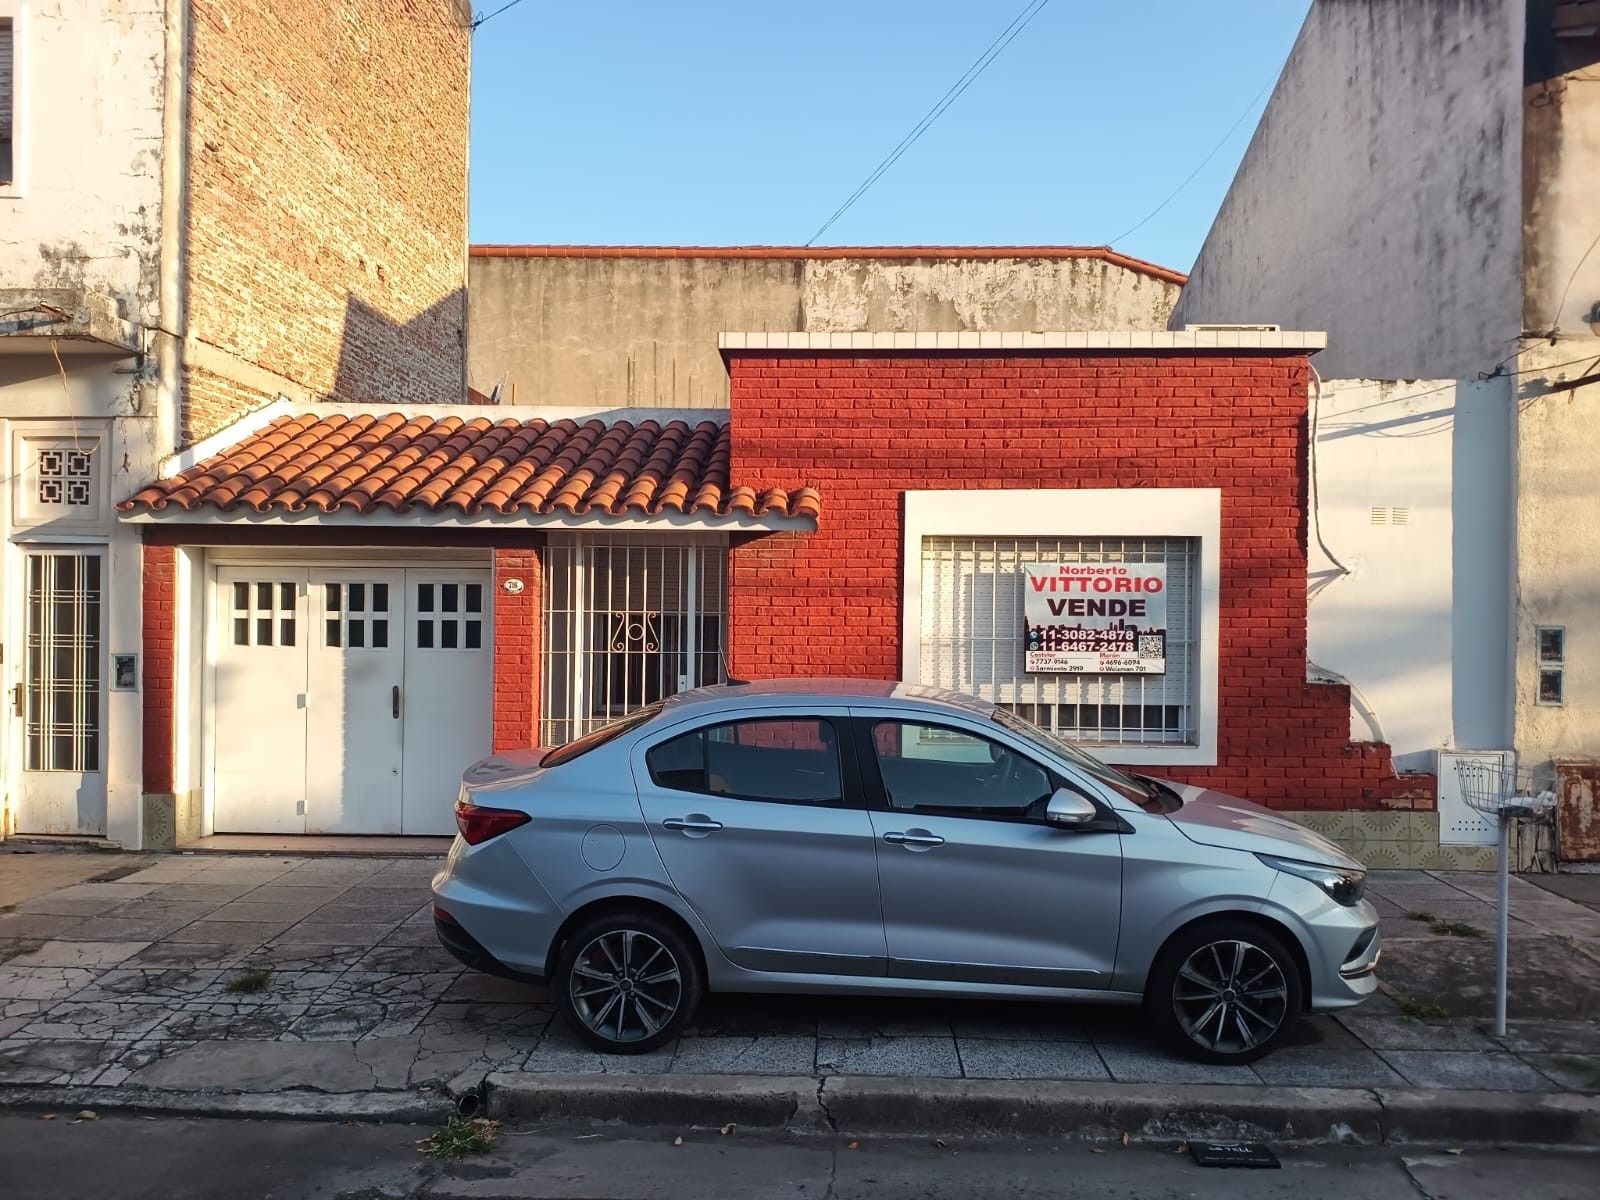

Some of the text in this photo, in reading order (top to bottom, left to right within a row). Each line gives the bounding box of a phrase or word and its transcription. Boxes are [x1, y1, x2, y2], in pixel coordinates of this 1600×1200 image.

[1060, 566, 1127, 575] Norberto
[1030, 576, 1163, 593] VITTORIO
[1046, 598, 1146, 617] VENDE
[1040, 630, 1134, 640] 11-3082-4878
[1040, 641, 1134, 652] 11-6467-2478
